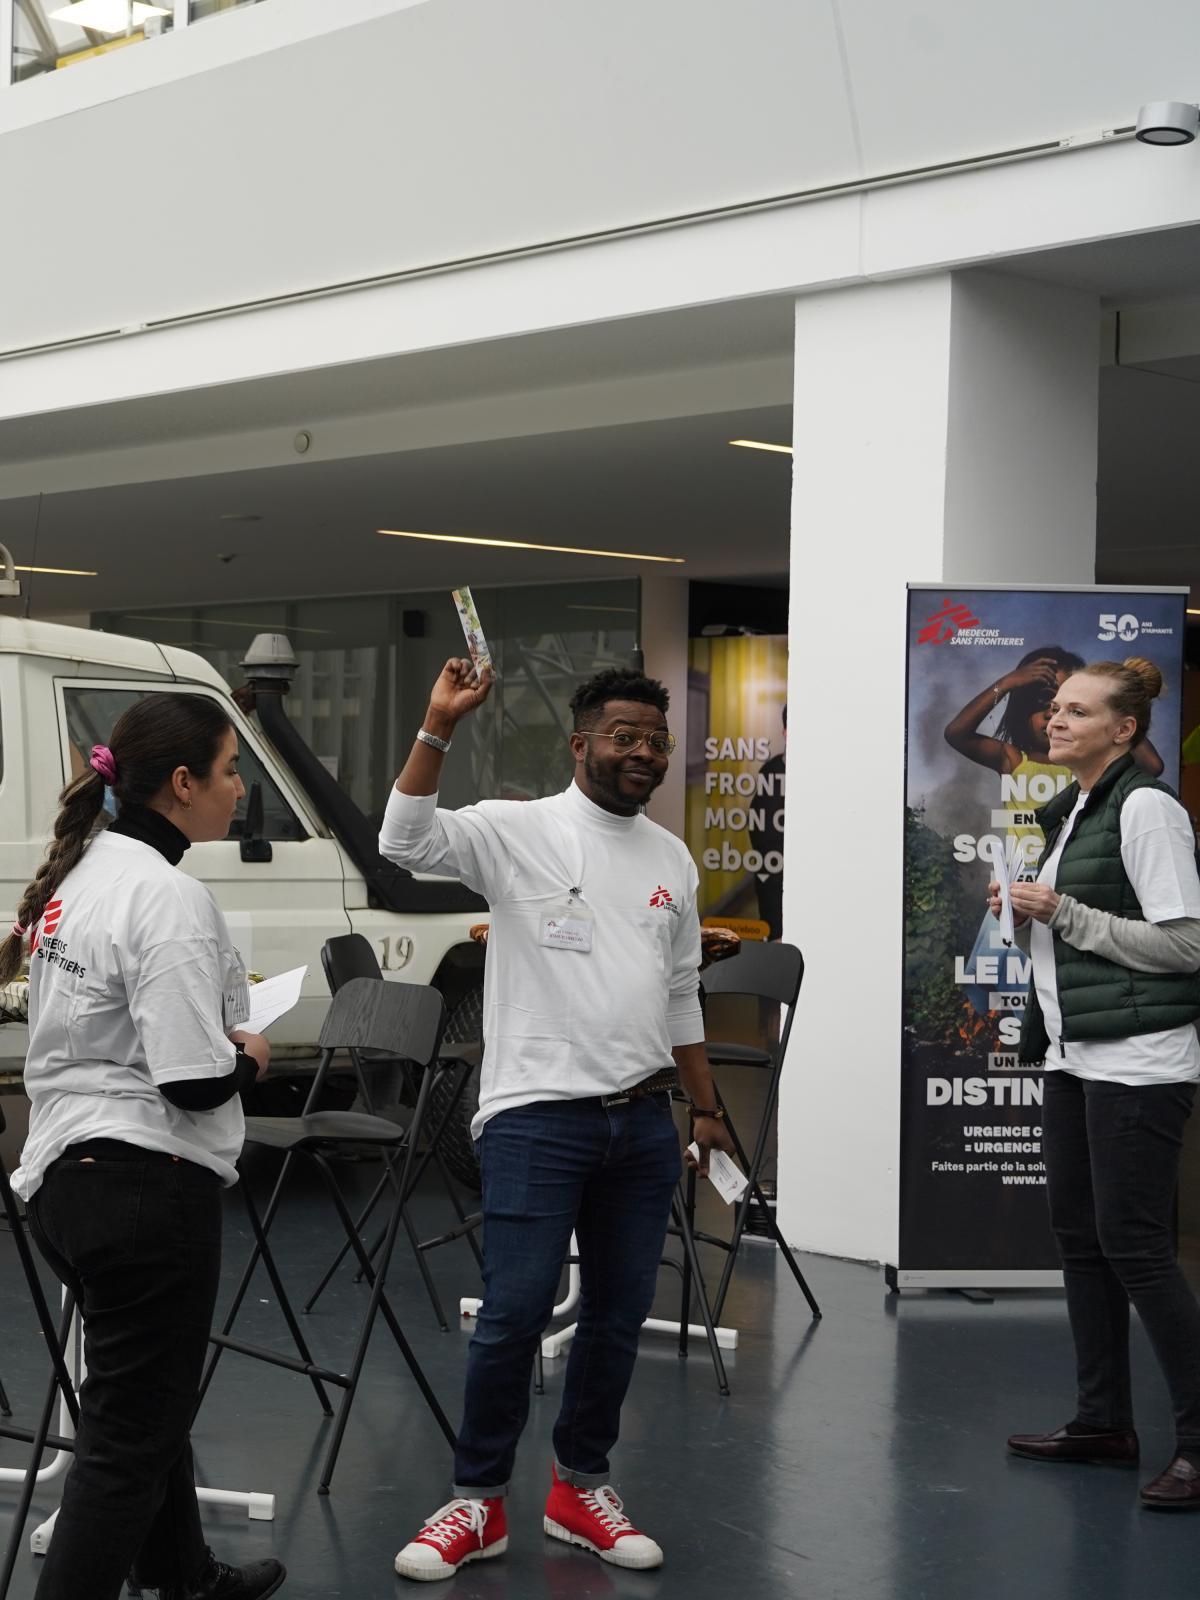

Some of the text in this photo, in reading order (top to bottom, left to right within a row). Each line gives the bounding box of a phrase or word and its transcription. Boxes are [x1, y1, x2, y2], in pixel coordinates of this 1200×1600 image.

[957, 628, 1001, 637] MEDECINS
[1097, 614, 1140, 642] 50
[950, 637, 1025, 646] SANS FRONTIERES
[704, 737, 770, 761] SANS
[704, 808, 766, 832] MON
[378, 936, 414, 971] 19
[954, 955, 999, 985] LE
[994, 1057, 1015, 1068] UN
[927, 1077, 1045, 1106] DISTIN
[963, 1126, 1031, 1138] URGENCE
[974, 1142, 1041, 1153] URGENCE
[931, 1161, 965, 1172] Faites
[966, 1161, 999, 1174] partie
[1000, 1161, 1014, 1172] de
[1015, 1161, 1026, 1172] la
